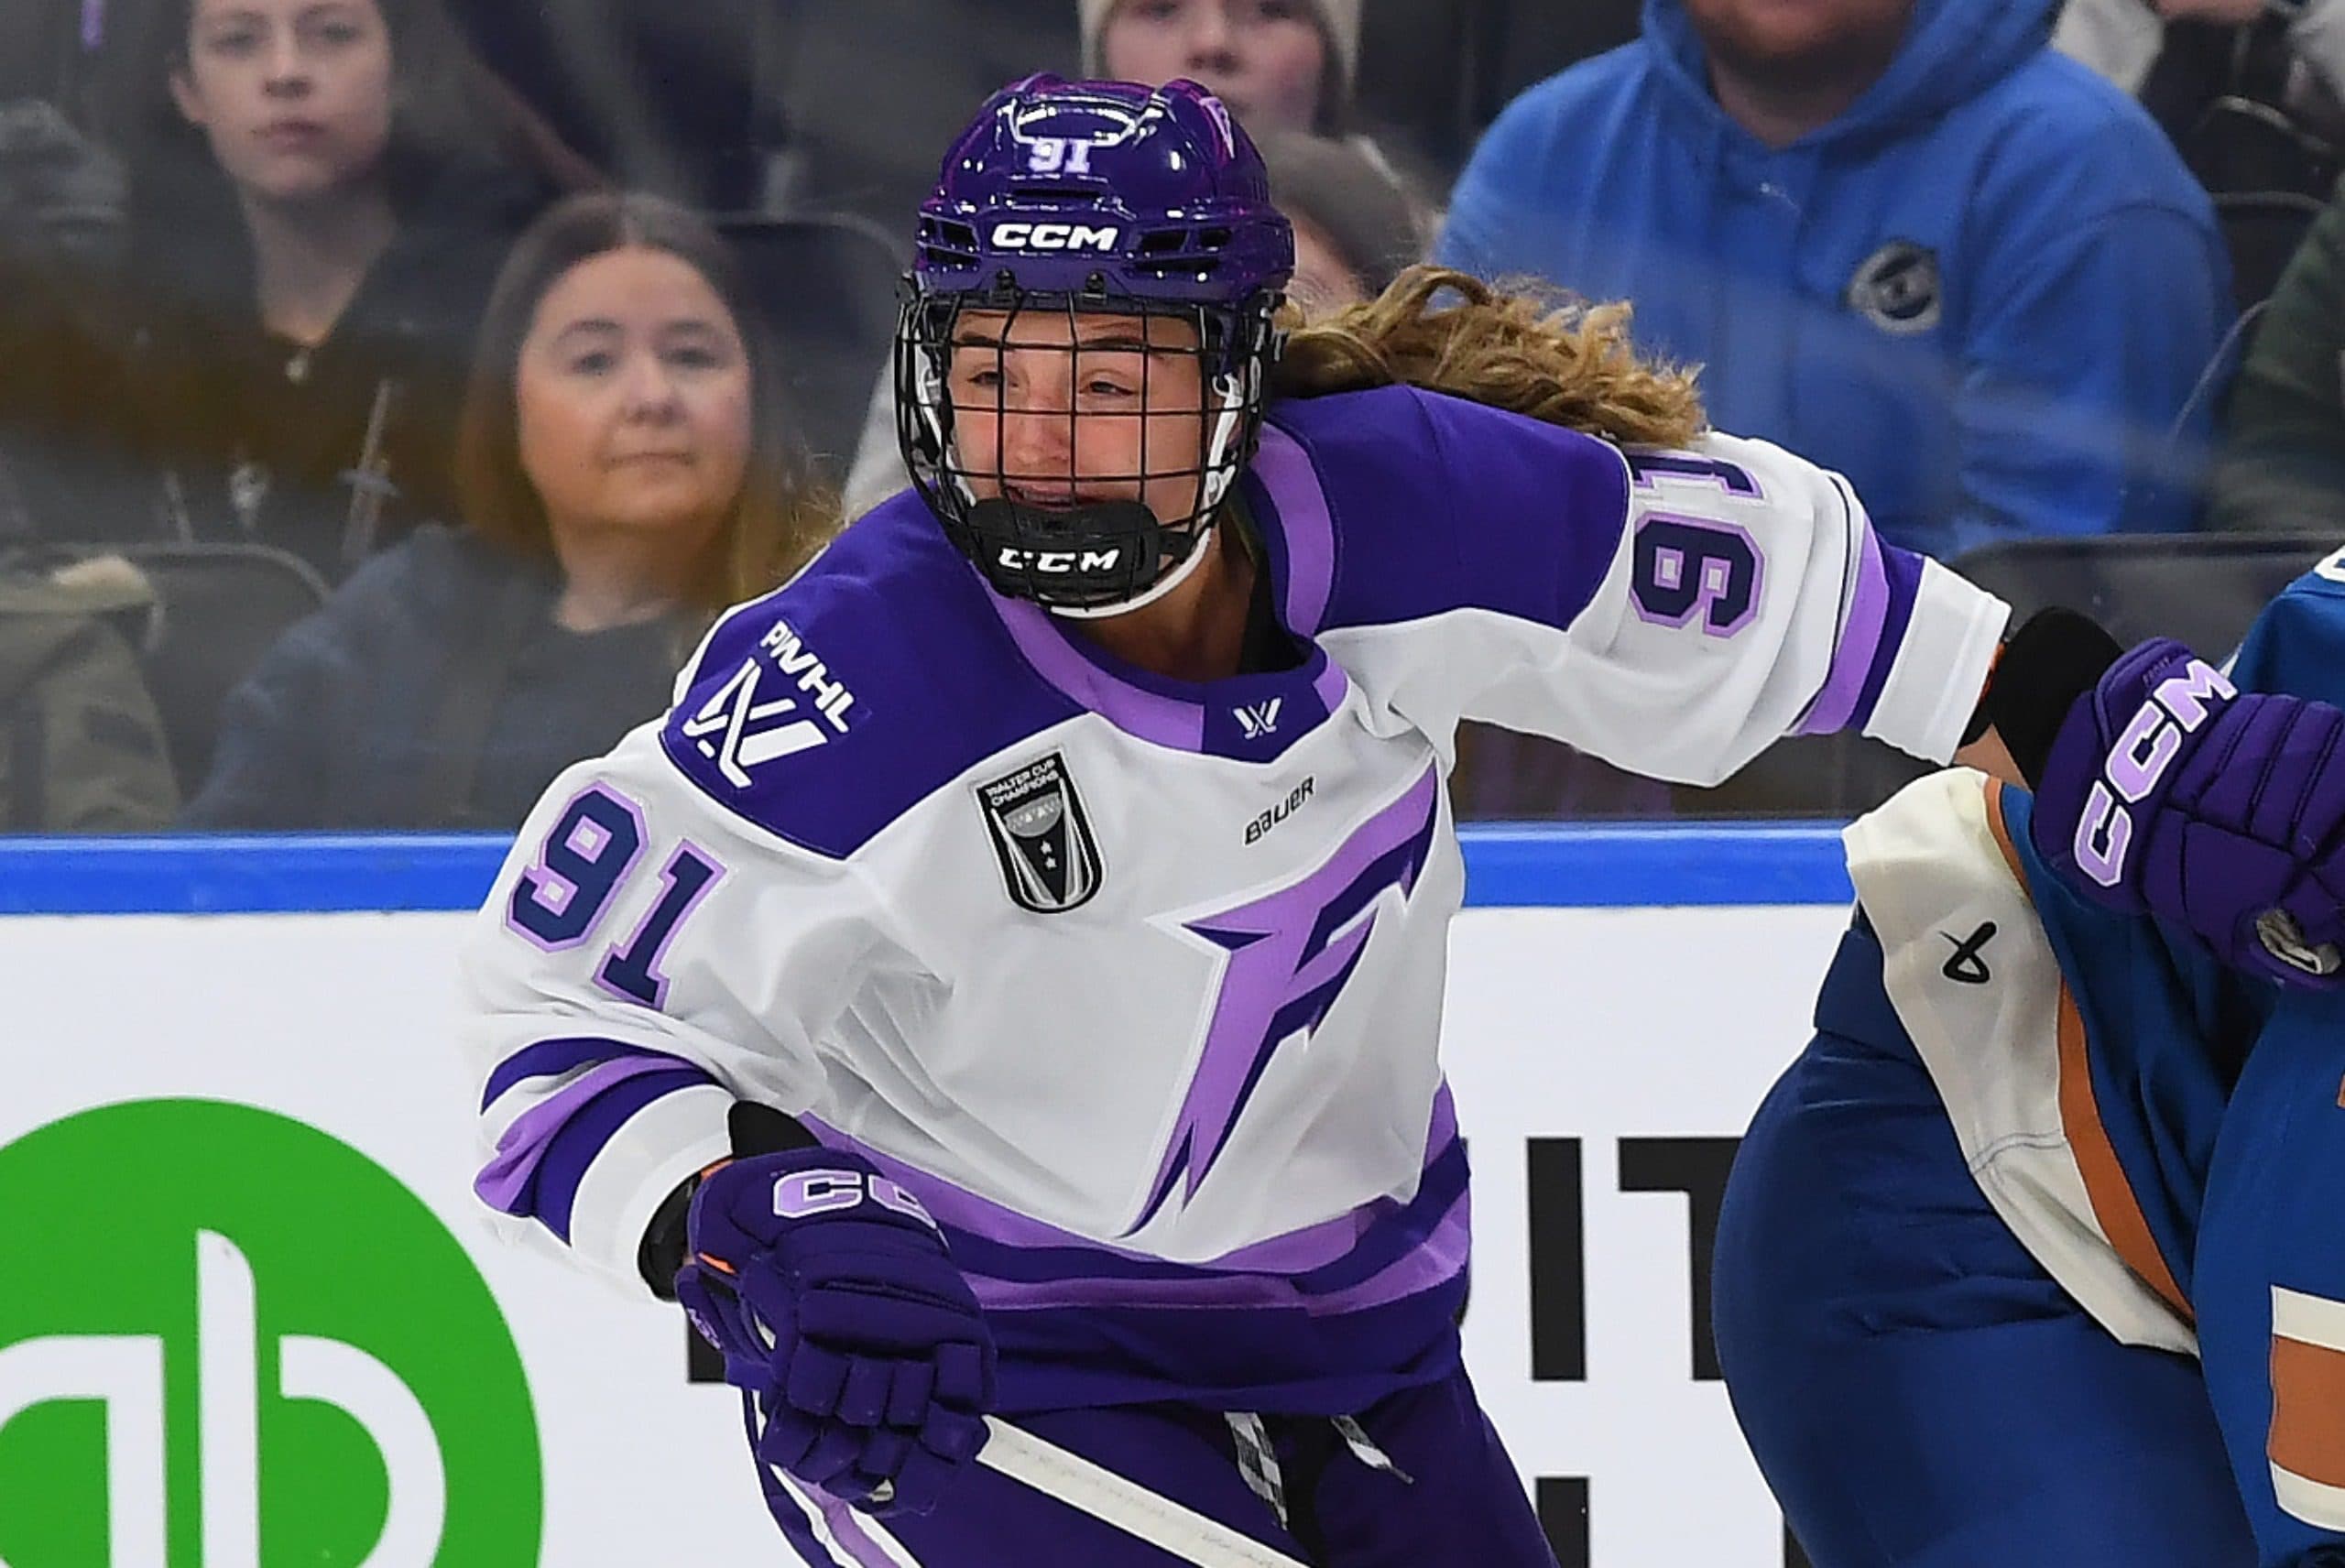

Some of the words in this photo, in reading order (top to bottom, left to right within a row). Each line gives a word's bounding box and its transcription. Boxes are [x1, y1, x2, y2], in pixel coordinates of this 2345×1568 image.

[1029, 137, 1091, 173] 91
[991, 223, 1118, 251] CCM
[998, 548, 1120, 572] CCM
[1627, 452, 1768, 638] 91
[759, 619, 850, 734] PWHL
[2074, 658, 2238, 887] CCM
[506, 779, 727, 1012] 91
[773, 1169, 947, 1244] CC
